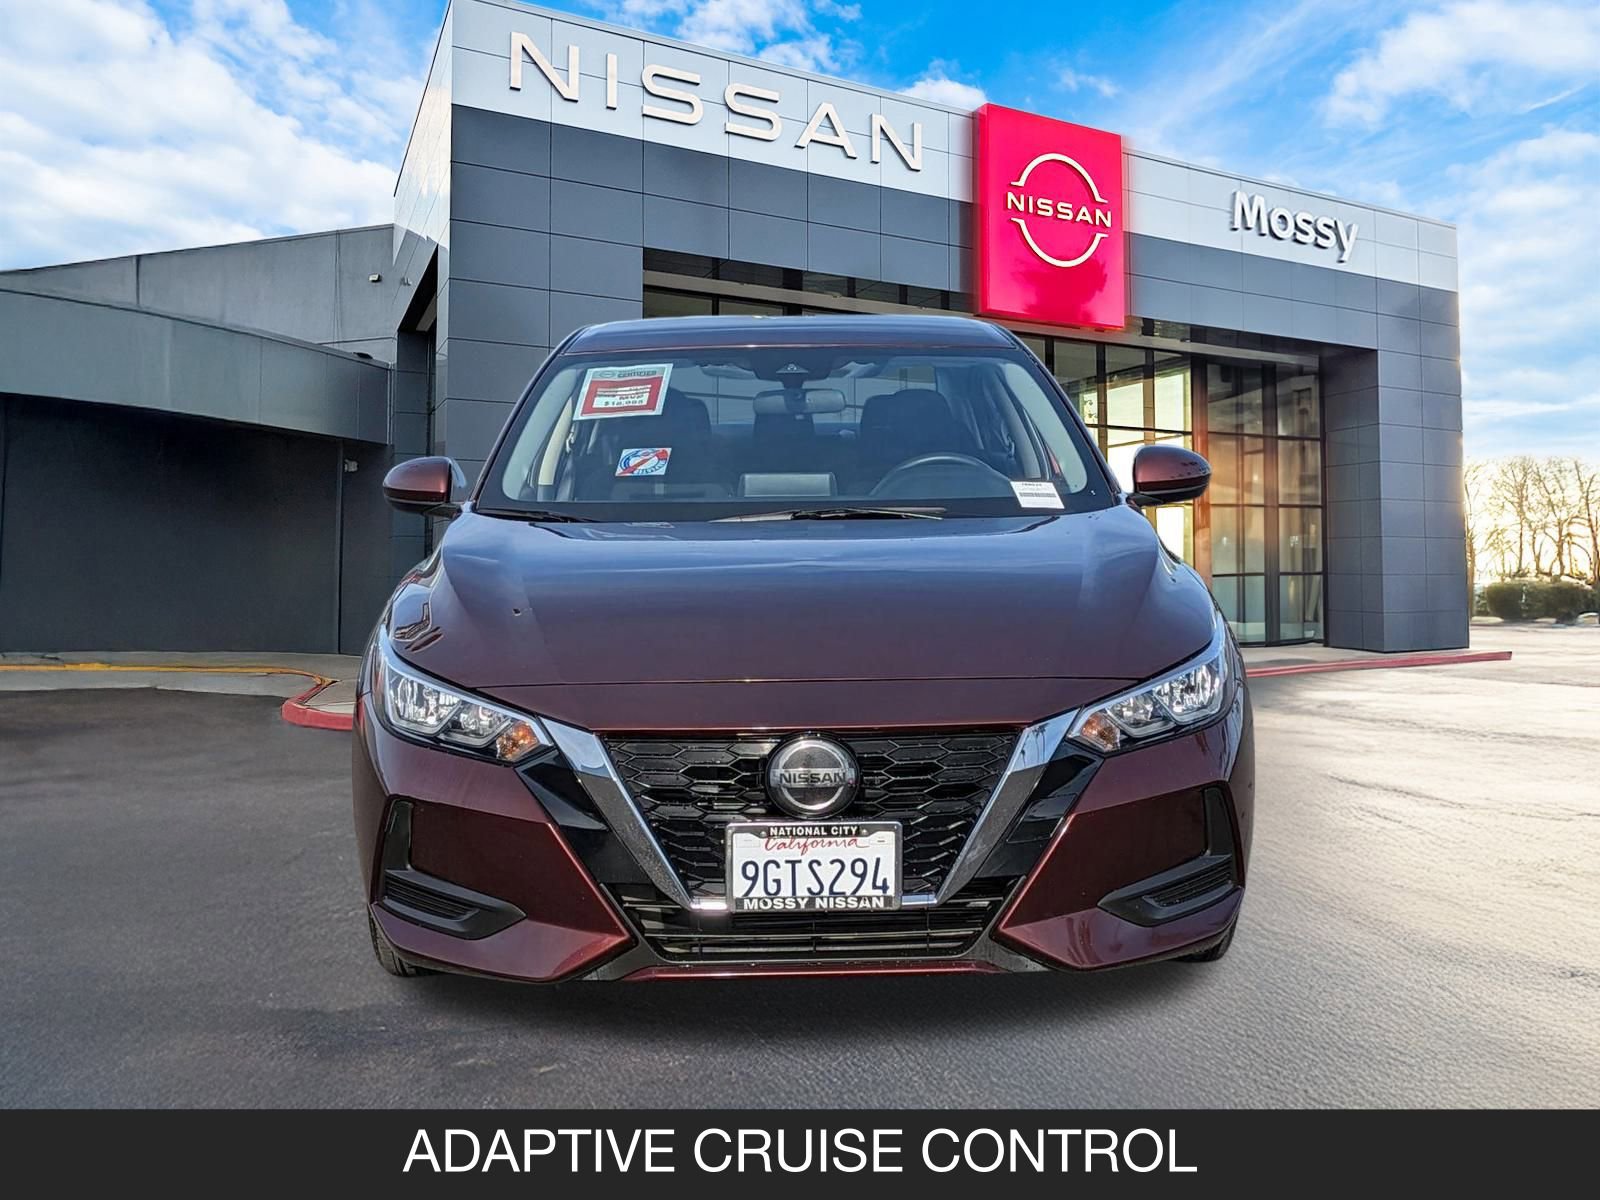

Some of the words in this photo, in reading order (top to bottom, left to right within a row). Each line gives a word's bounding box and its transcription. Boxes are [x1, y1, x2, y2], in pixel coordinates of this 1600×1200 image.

[510, 31, 922, 172] NISSAN
[1006, 191, 1112, 228] NISSAN
[1230, 189, 1359, 264] Mossy
[779, 772, 847, 784] NISSAN
[769, 826, 828, 837] NATIONAL
[832, 825, 859, 836] CITY
[764, 837, 870, 856] California
[741, 857, 890, 898] 9GTS294
[743, 897, 808, 910] MOSSY
[815, 896, 885, 909] NISSAN
